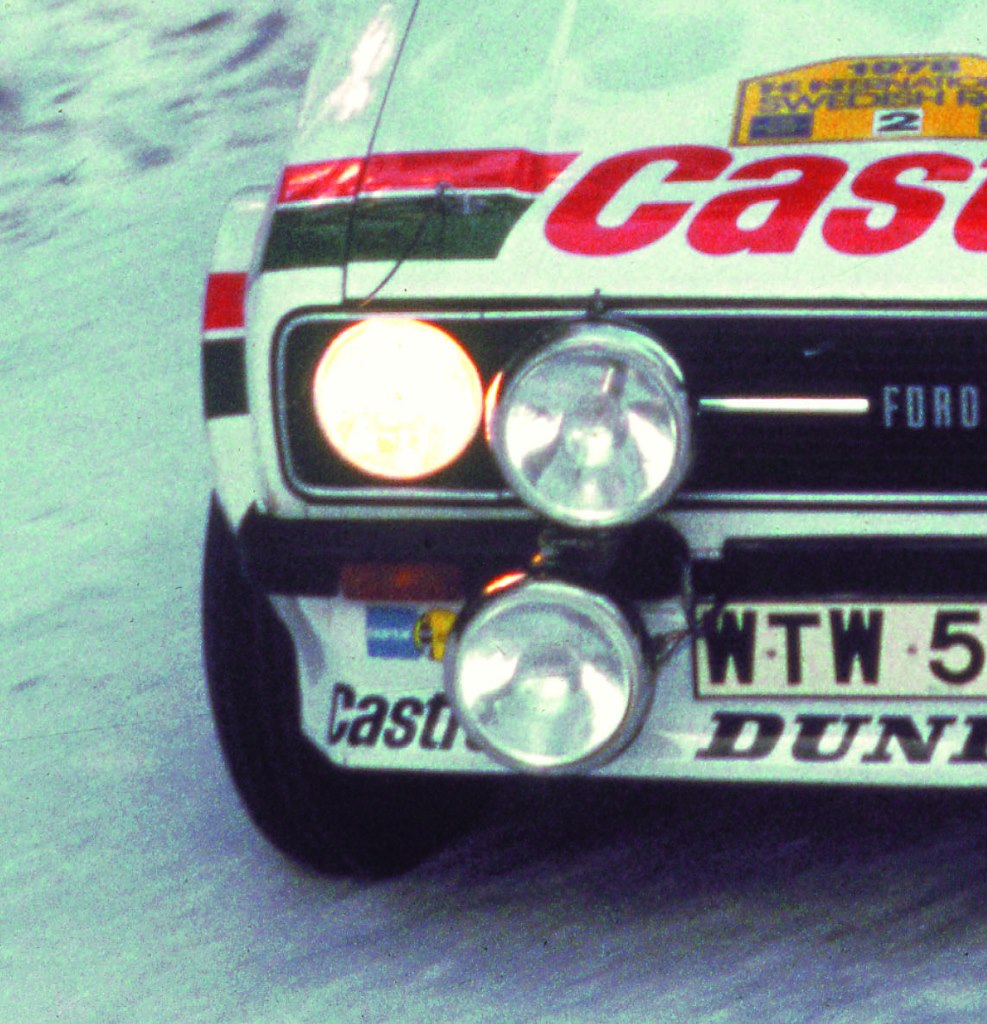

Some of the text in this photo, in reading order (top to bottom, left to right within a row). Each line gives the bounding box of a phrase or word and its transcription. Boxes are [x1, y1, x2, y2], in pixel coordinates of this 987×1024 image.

[877, 110, 921, 133] 2
[882, 384, 979, 429] FORD
[702, 608, 884, 686] WTW
